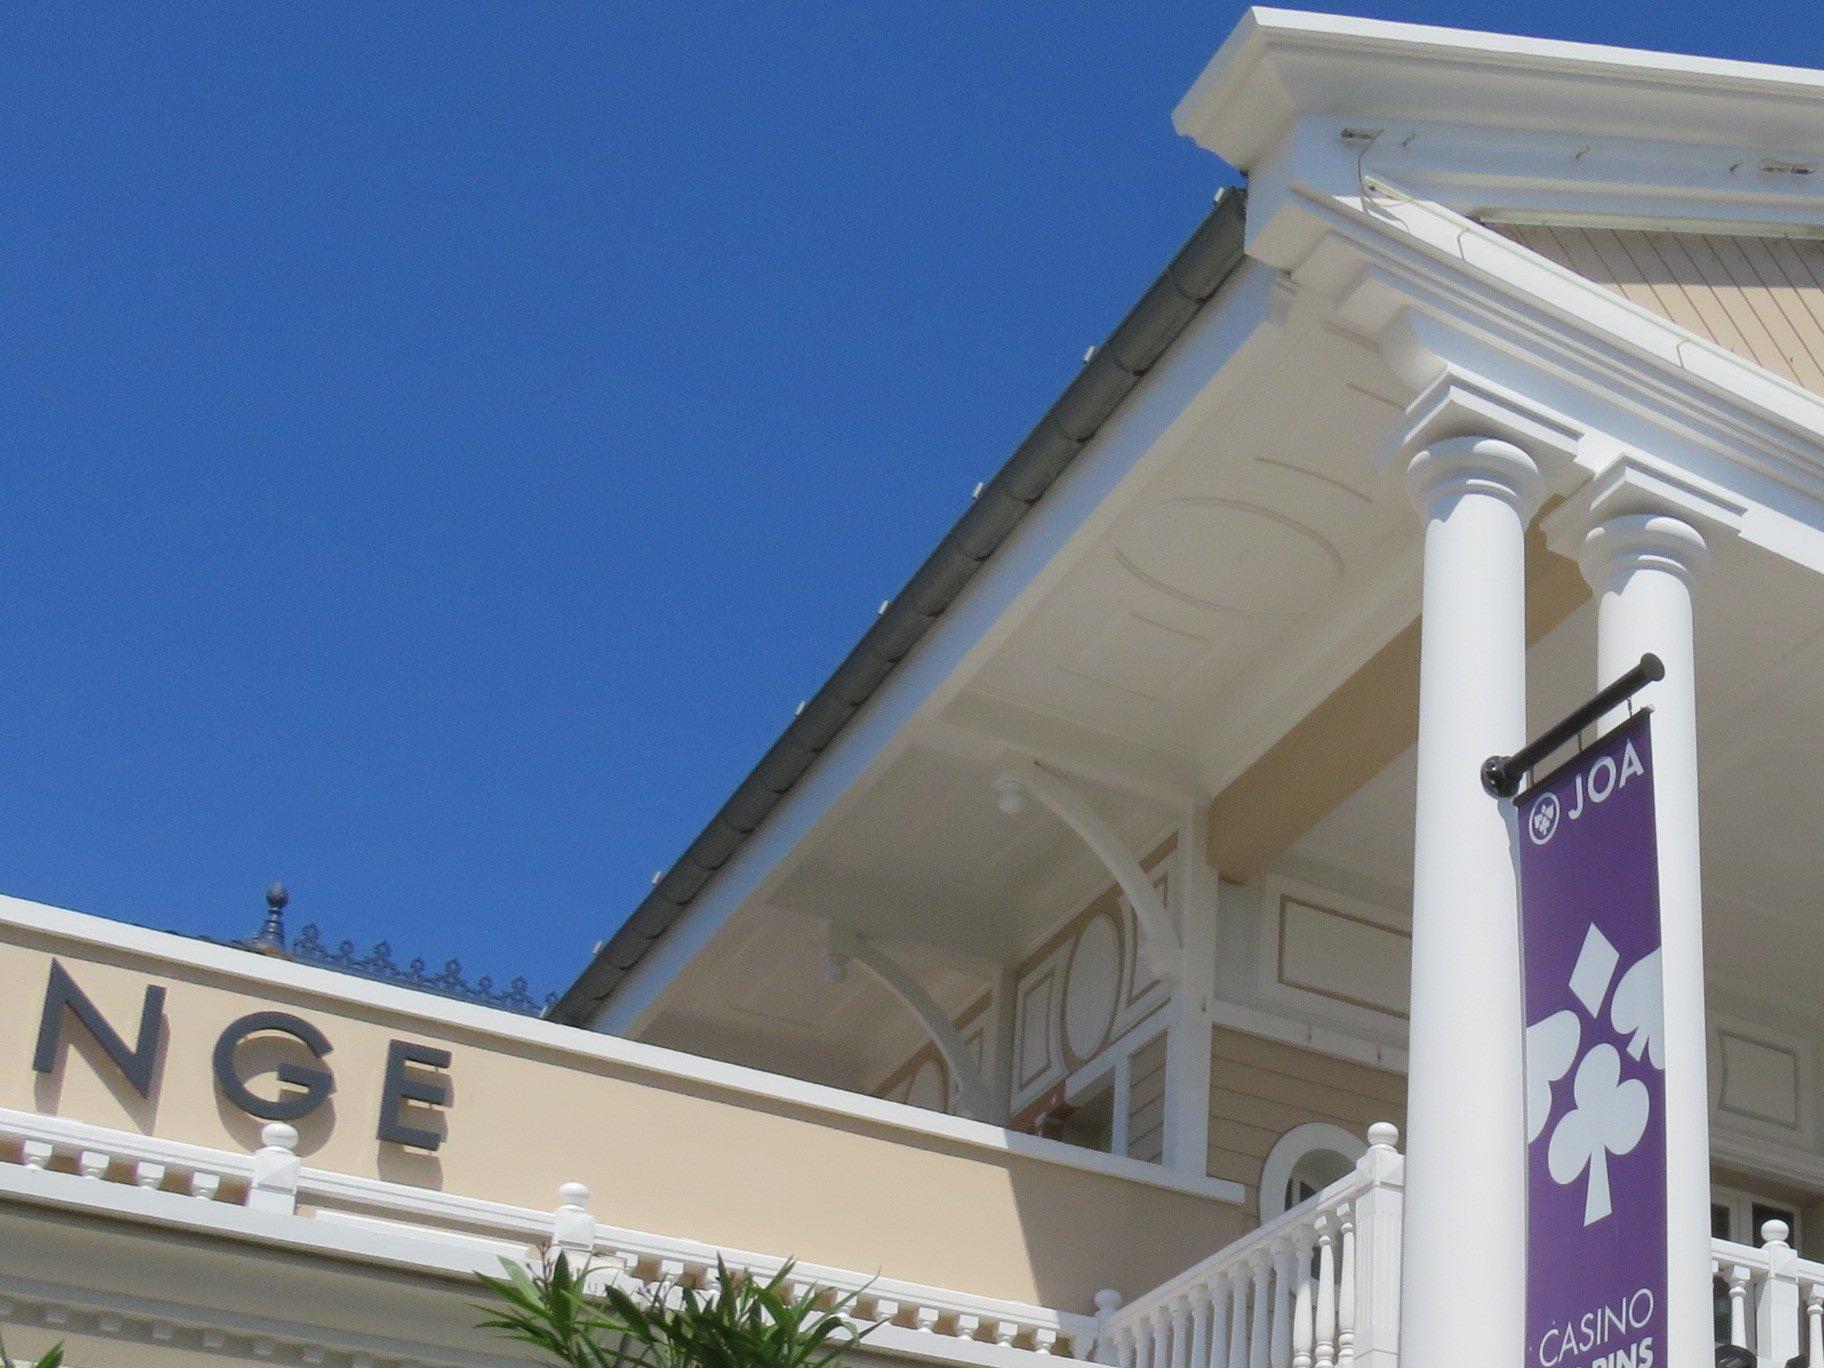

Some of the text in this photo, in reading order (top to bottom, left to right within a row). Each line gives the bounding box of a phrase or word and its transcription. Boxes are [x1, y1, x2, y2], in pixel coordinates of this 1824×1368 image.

[1567, 738, 1645, 821] JOA
[33, 957, 453, 1151] NGE
[1538, 1287, 1654, 1368] CASINO
